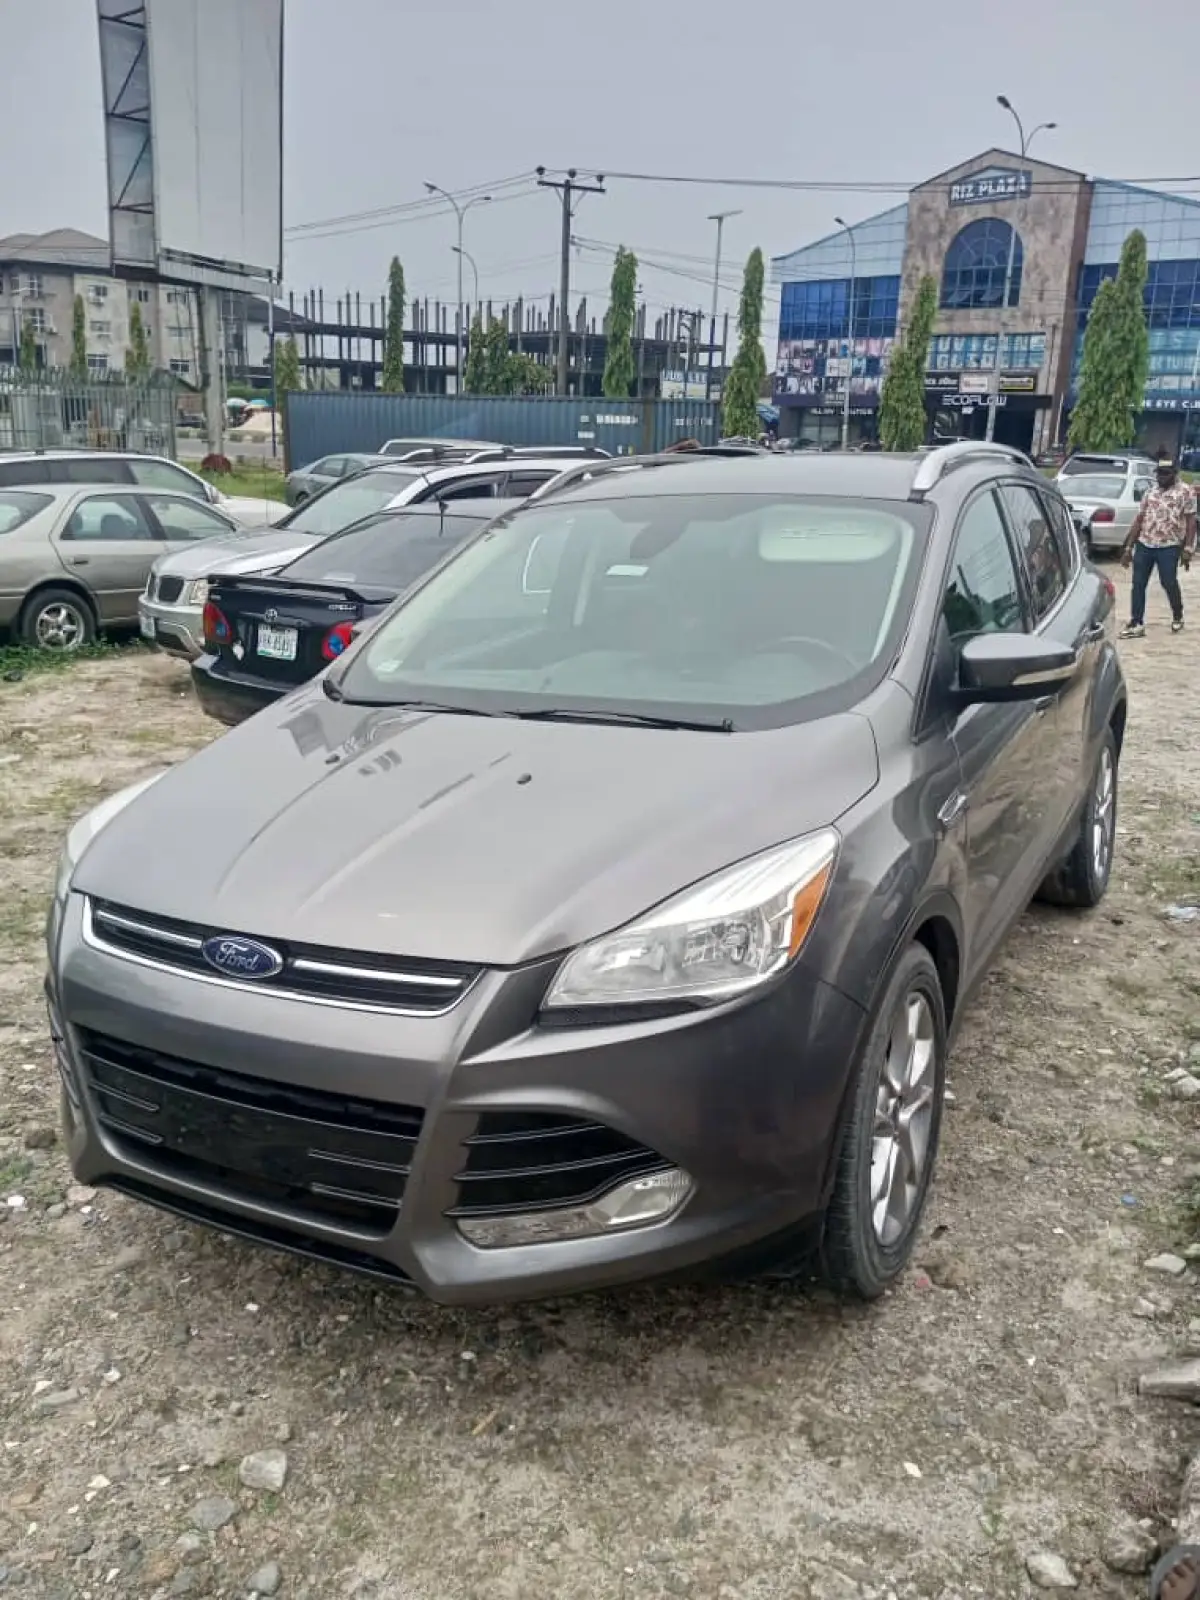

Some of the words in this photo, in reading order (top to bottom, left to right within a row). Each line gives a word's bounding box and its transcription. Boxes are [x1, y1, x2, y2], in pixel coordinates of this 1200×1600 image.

[951, 184, 975, 201] RIZ
[979, 175, 1026, 197] PLAZA
[941, 394, 1007, 406] ECOFLOW
[215, 941, 260, 971] Ford
